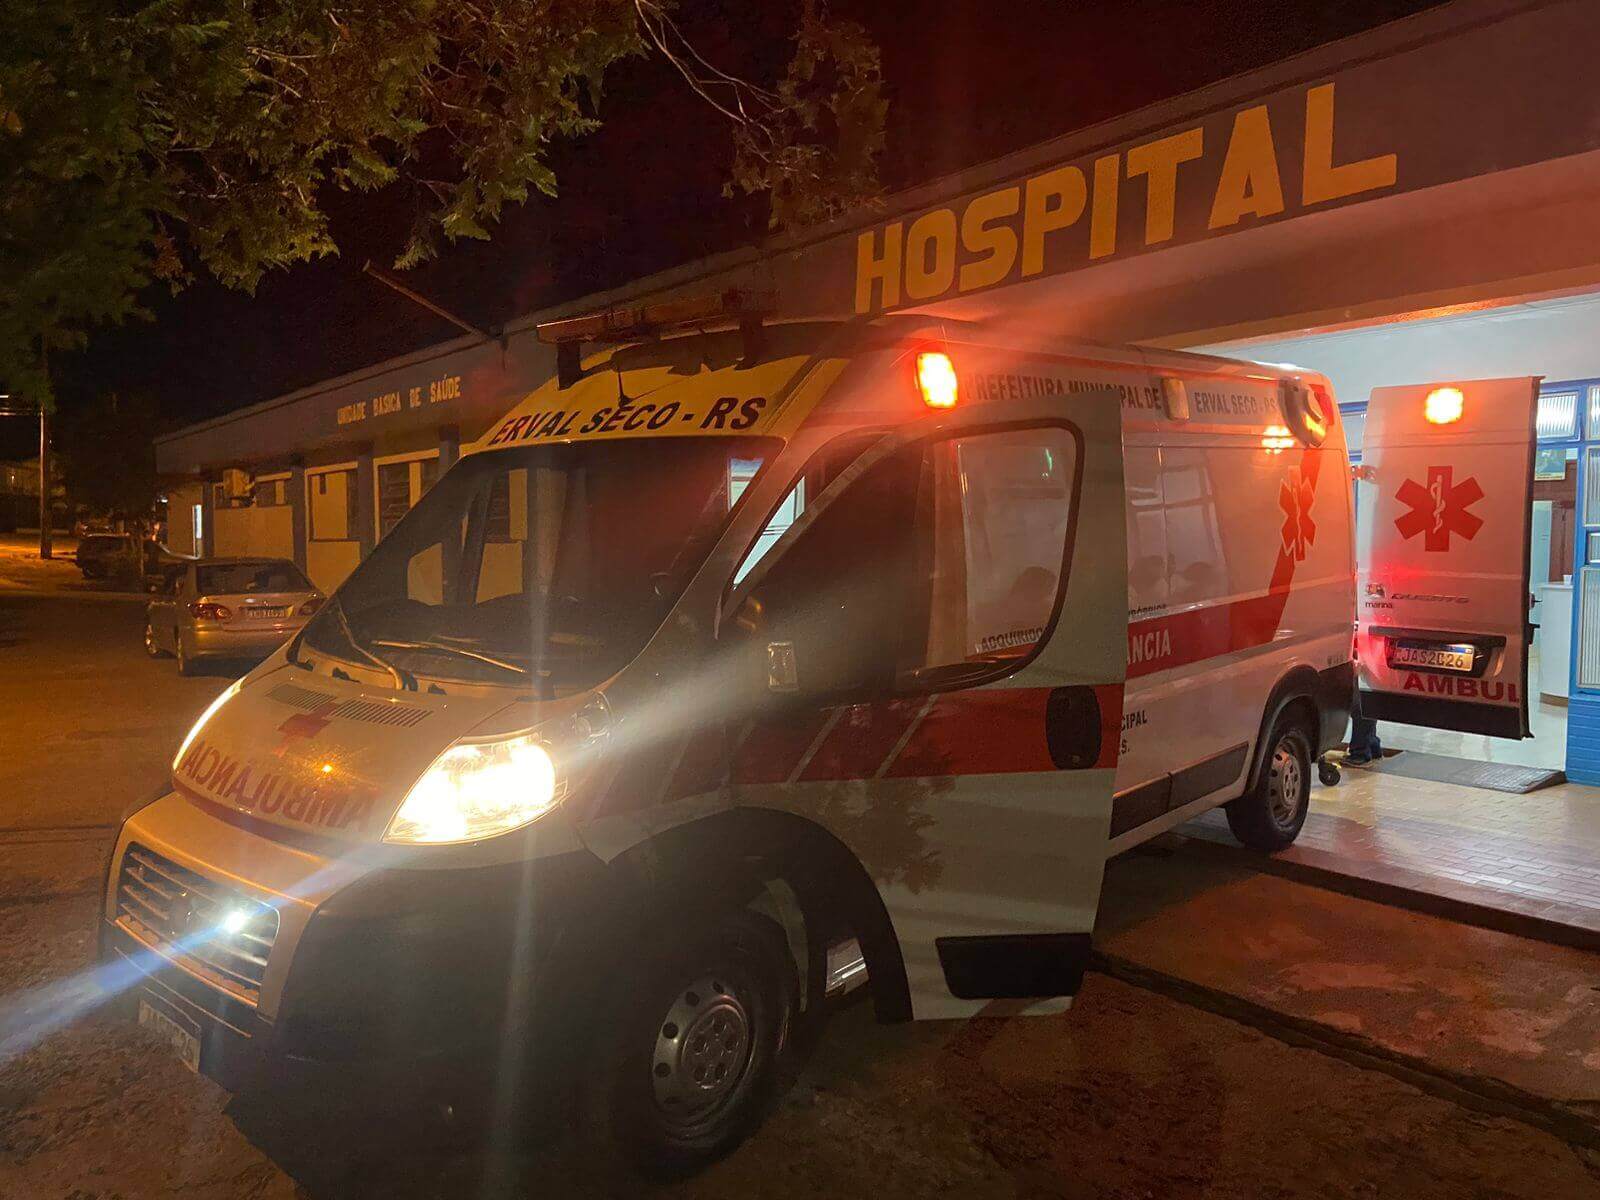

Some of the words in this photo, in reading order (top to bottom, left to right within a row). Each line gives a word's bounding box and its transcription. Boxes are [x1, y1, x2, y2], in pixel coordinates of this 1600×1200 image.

[855, 82, 1397, 313] HOSPITAL
[409, 387, 421, 408] DE
[430, 374, 461, 403] SAÚDE
[1144, 386, 1162, 409] DE
[1194, 392, 1230, 413] ERVAL
[488, 411, 581, 447] ERVAL
[579, 401, 680, 434] SECO
[700, 397, 767, 430] RS
